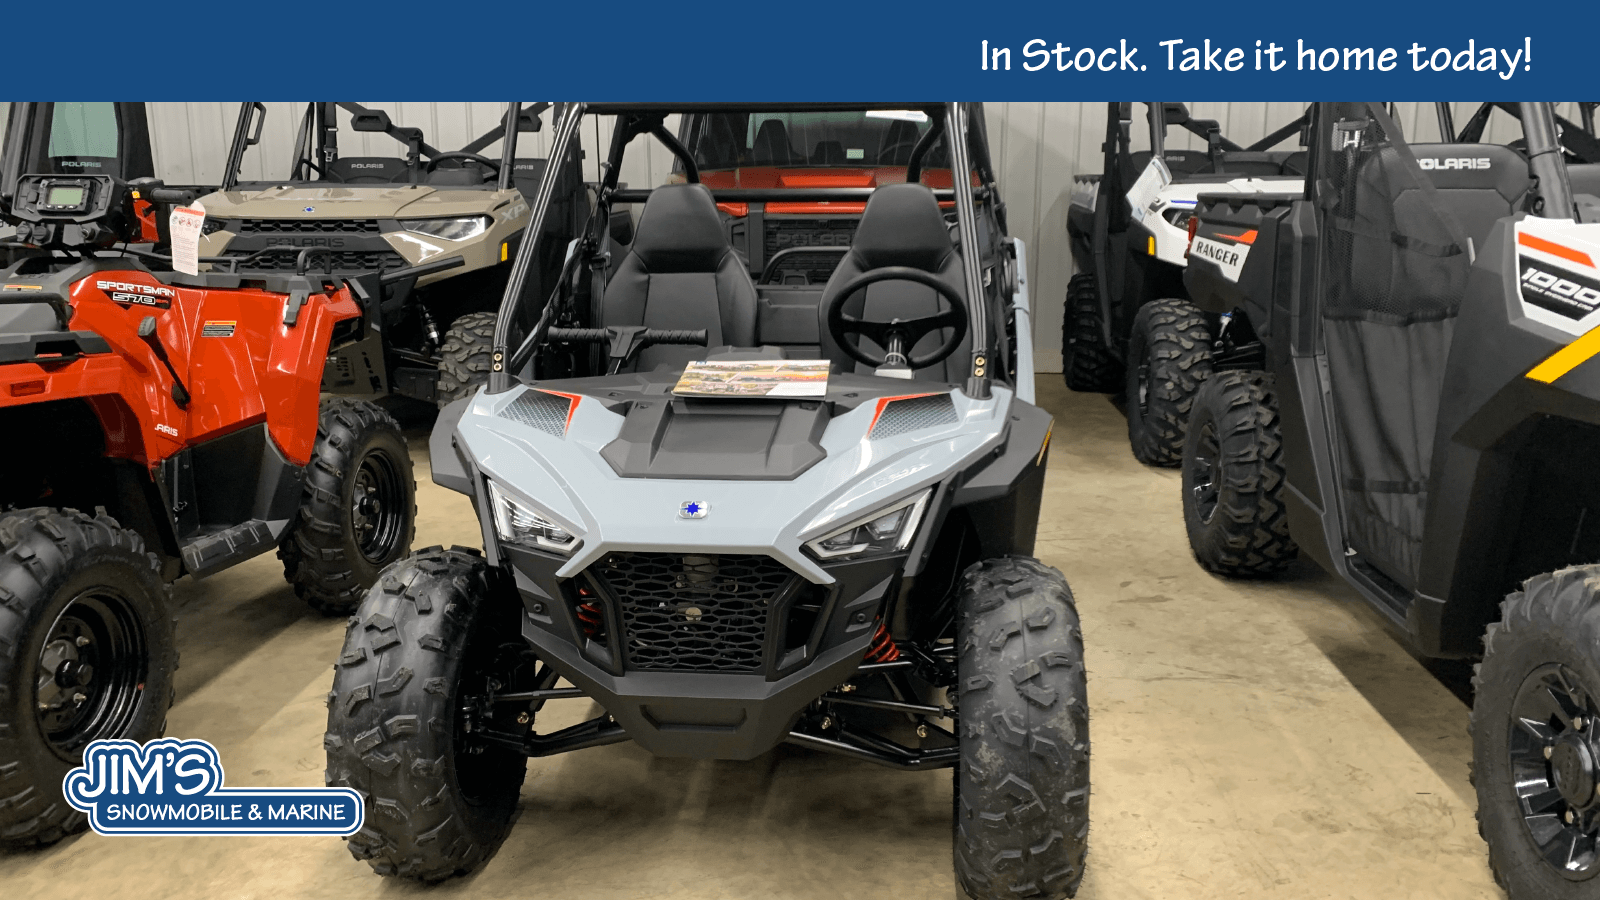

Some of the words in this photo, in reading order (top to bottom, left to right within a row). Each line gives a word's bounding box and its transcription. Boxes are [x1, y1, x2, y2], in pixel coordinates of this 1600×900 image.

[1416, 157, 1492, 170] OLARIS
[501, 203, 526, 225] XP
[776, 233, 852, 247] POLAR
[1196, 241, 1240, 267] RANGER
[96, 280, 175, 297] SPORTSMAN
[1521, 267, 1600, 305] 1000
[154, 423, 179, 437] ARIS
